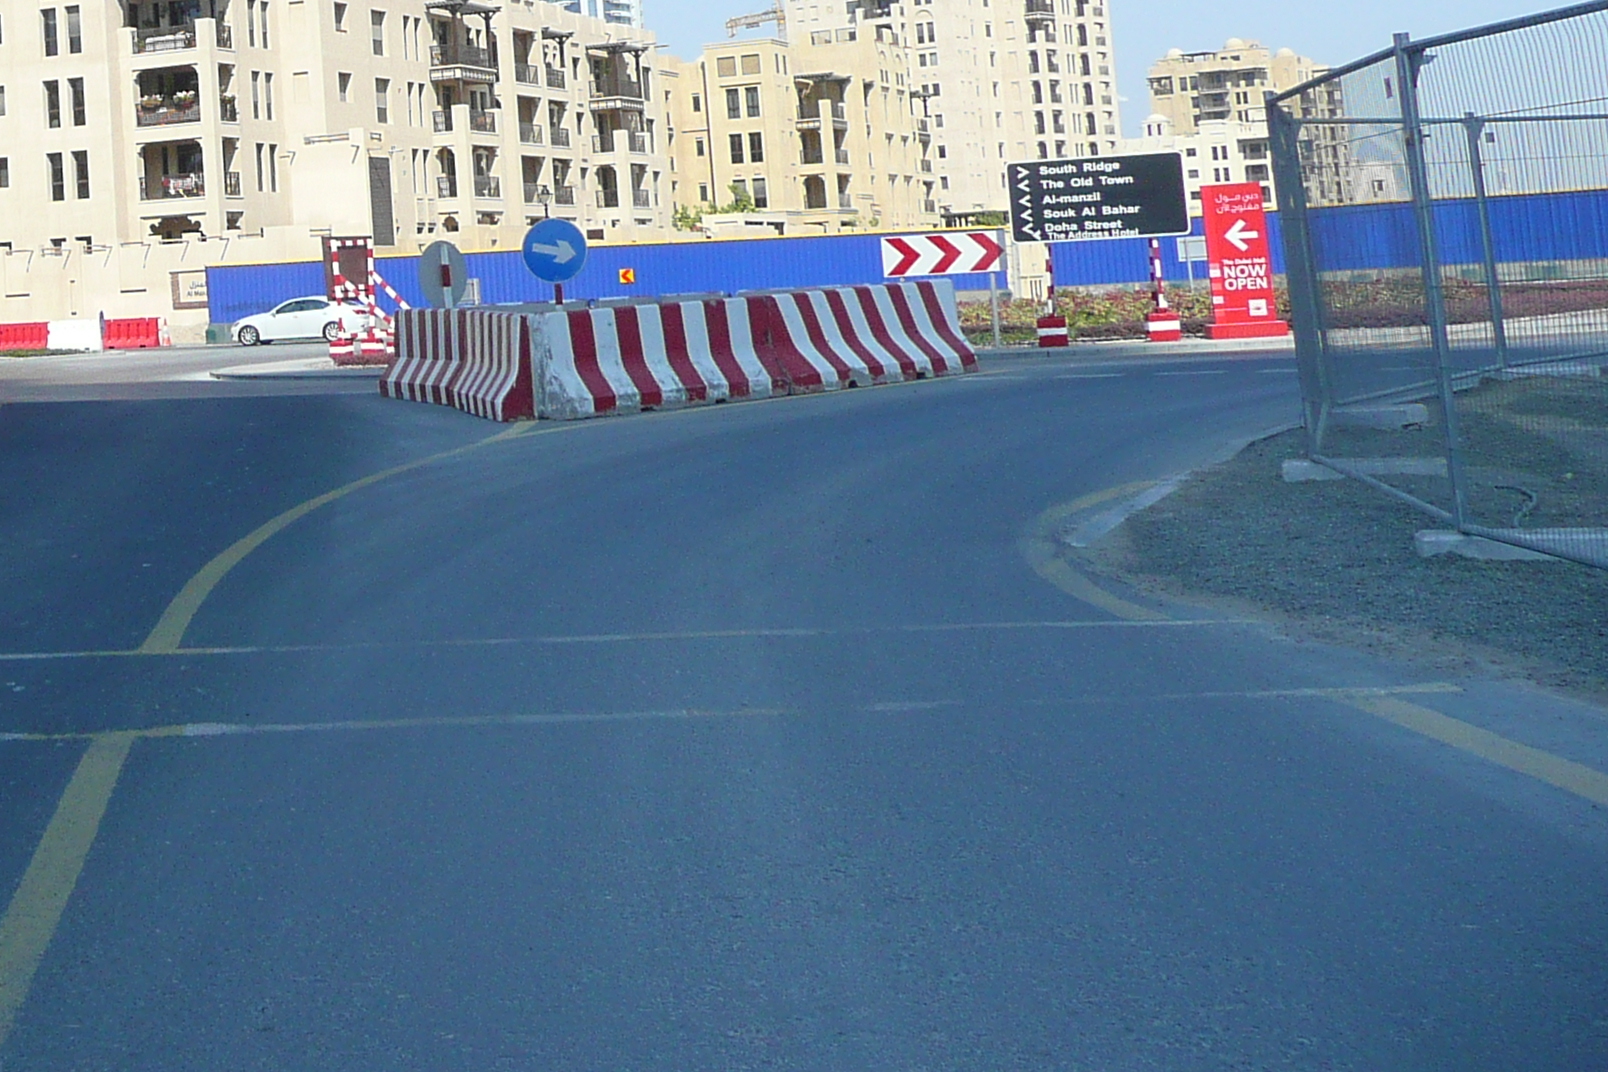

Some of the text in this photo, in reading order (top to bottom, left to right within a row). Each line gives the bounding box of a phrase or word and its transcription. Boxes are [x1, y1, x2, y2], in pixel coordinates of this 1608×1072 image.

[1039, 161, 1121, 175] South Ridge
[1040, 175, 1134, 189] The Old Town
[1043, 192, 1101, 204] Al-manzil
[1043, 204, 1141, 218] Souk Al Bahar
[1044, 219, 1123, 232] Doha Street
[1047, 227, 1140, 240] The Address Hotel
[1223, 264, 1267, 279] NOW
[1224, 276, 1268, 291] OPEN
